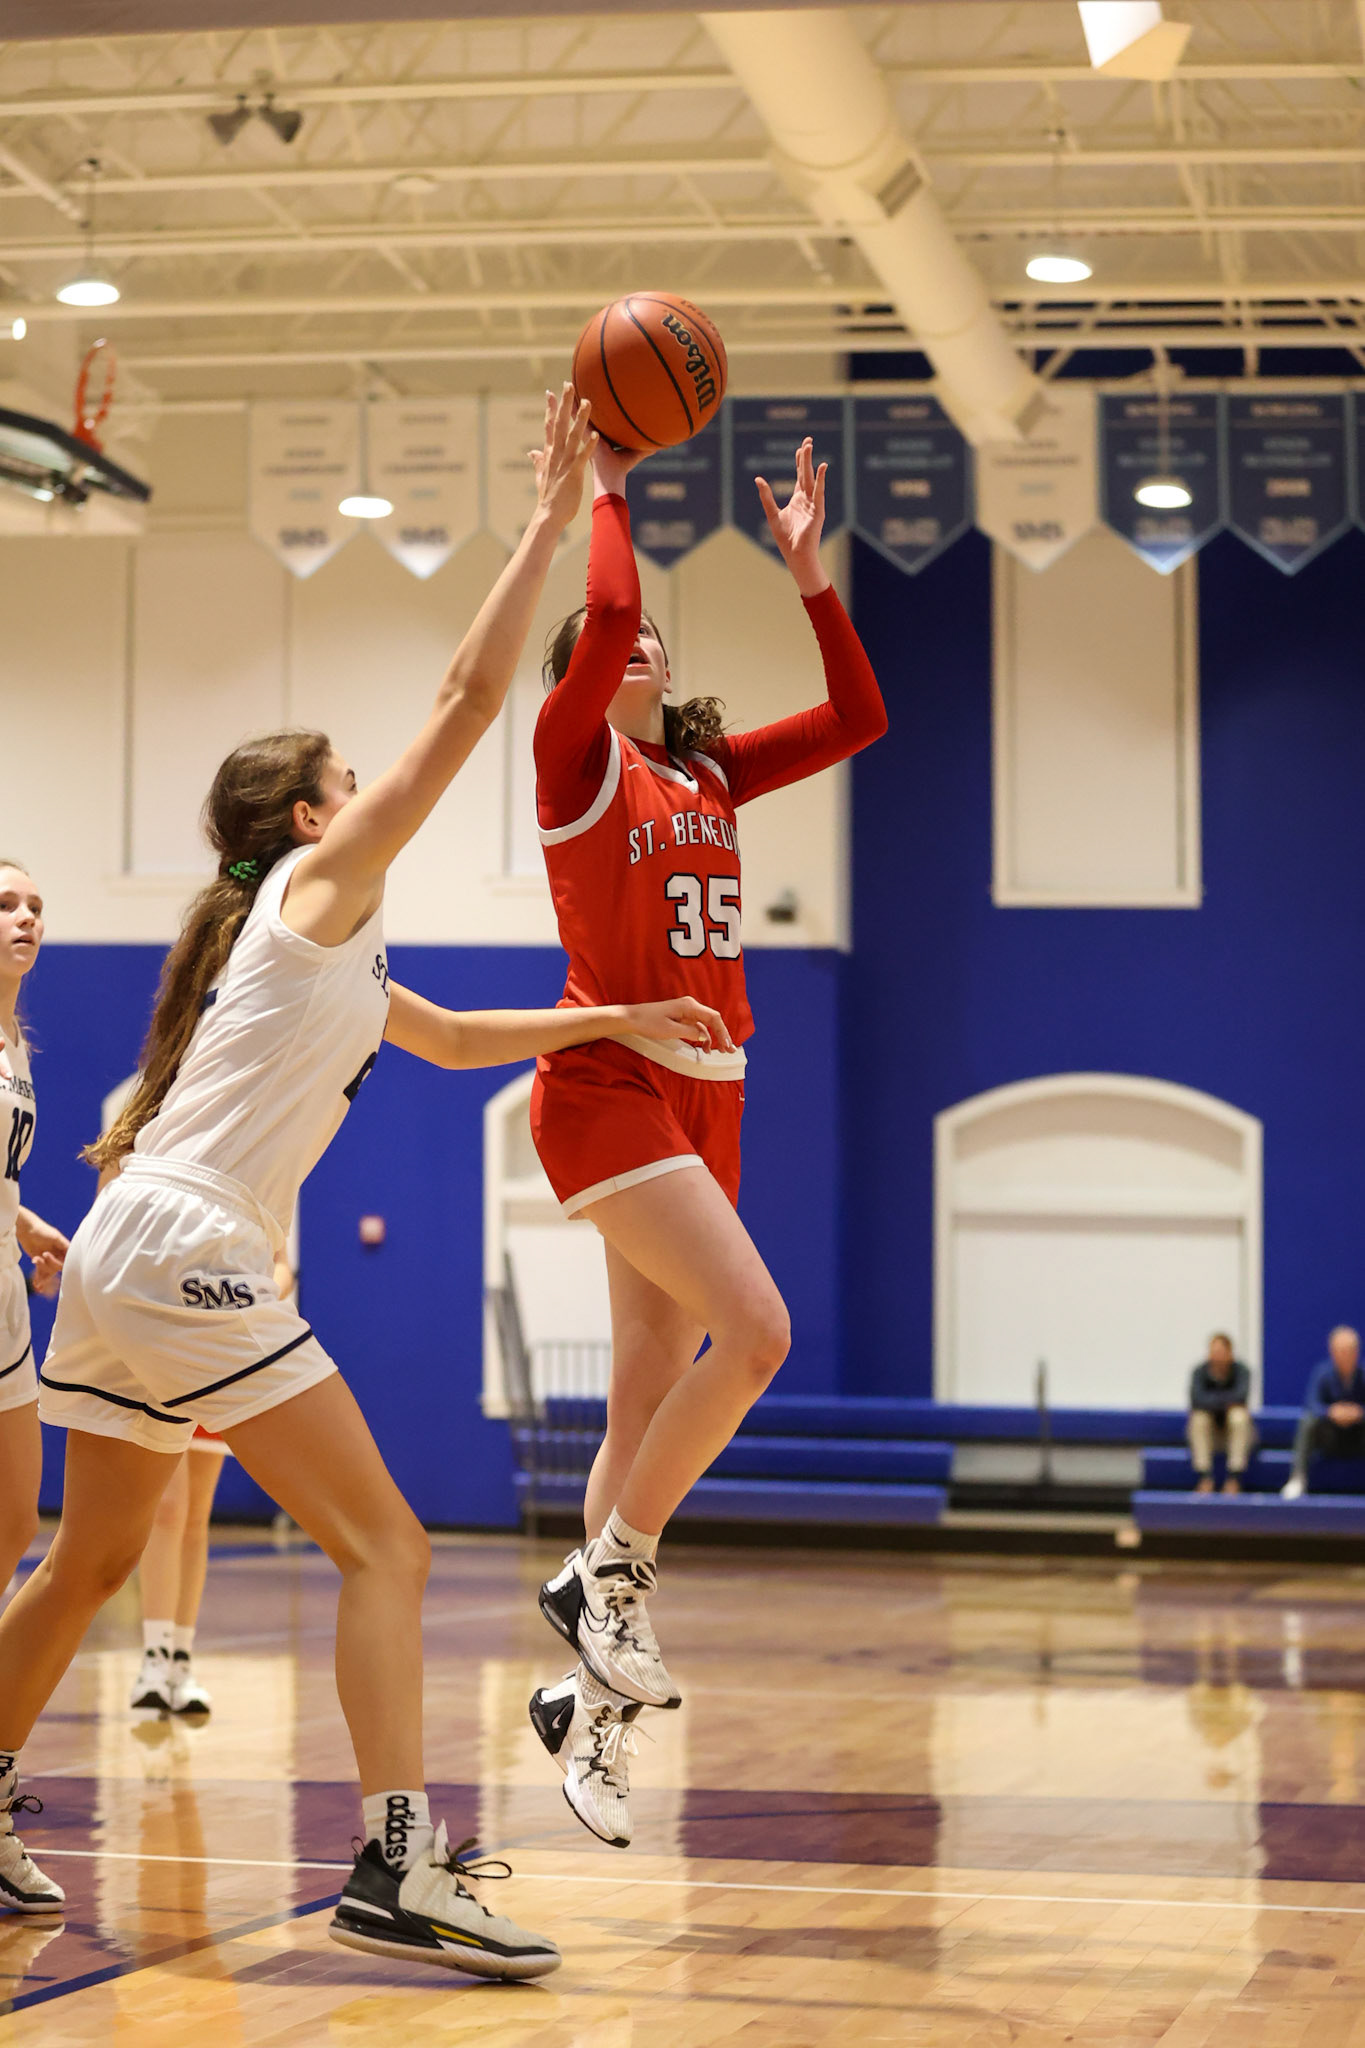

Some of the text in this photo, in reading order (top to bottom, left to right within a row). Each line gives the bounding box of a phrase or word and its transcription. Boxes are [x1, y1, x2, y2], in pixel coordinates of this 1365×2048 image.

[661, 313, 716, 412] Wilson
[628, 819, 666, 865] ST.
[665, 872, 741, 960] 35
[180, 1277, 255, 1309] SMS
[385, 1795, 416, 1859] adidas
